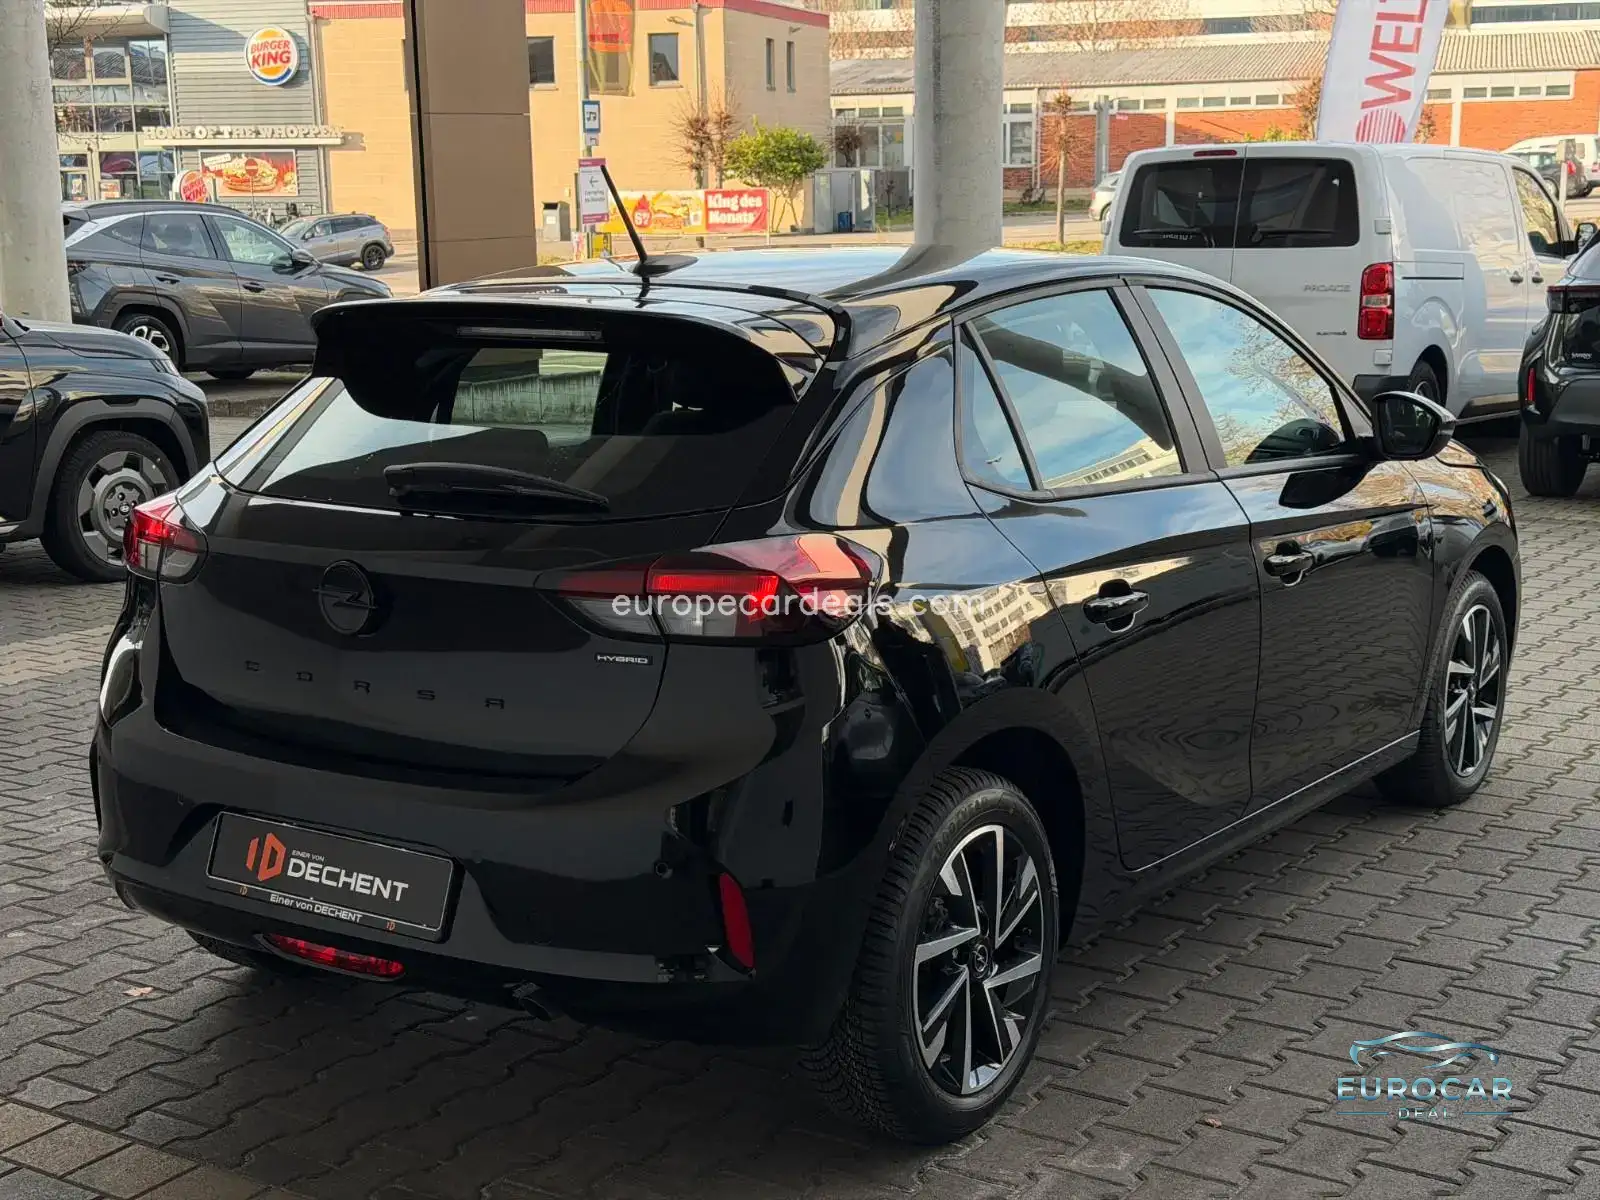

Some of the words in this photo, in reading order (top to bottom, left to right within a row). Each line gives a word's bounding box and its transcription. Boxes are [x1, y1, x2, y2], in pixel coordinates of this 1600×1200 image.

[250, 40, 291, 54] BURGER
[1360, 0, 1428, 109] WEL
[251, 51, 291, 69] KING
[143, 126, 192, 140] HOME
[194, 126, 217, 139] OF
[217, 126, 257, 139] THE
[707, 193, 739, 212] King
[740, 193, 763, 207] des
[596, 654, 649, 665] HYBRID
[245, 660, 505, 710] CORSA
[291, 849, 311, 859] EINER
[311, 853, 325, 863] VON
[286, 858, 409, 902] DECHENT
[270, 892, 296, 908] Einer
[296, 900, 313, 911] von
[314, 904, 363, 923] DECHENT
